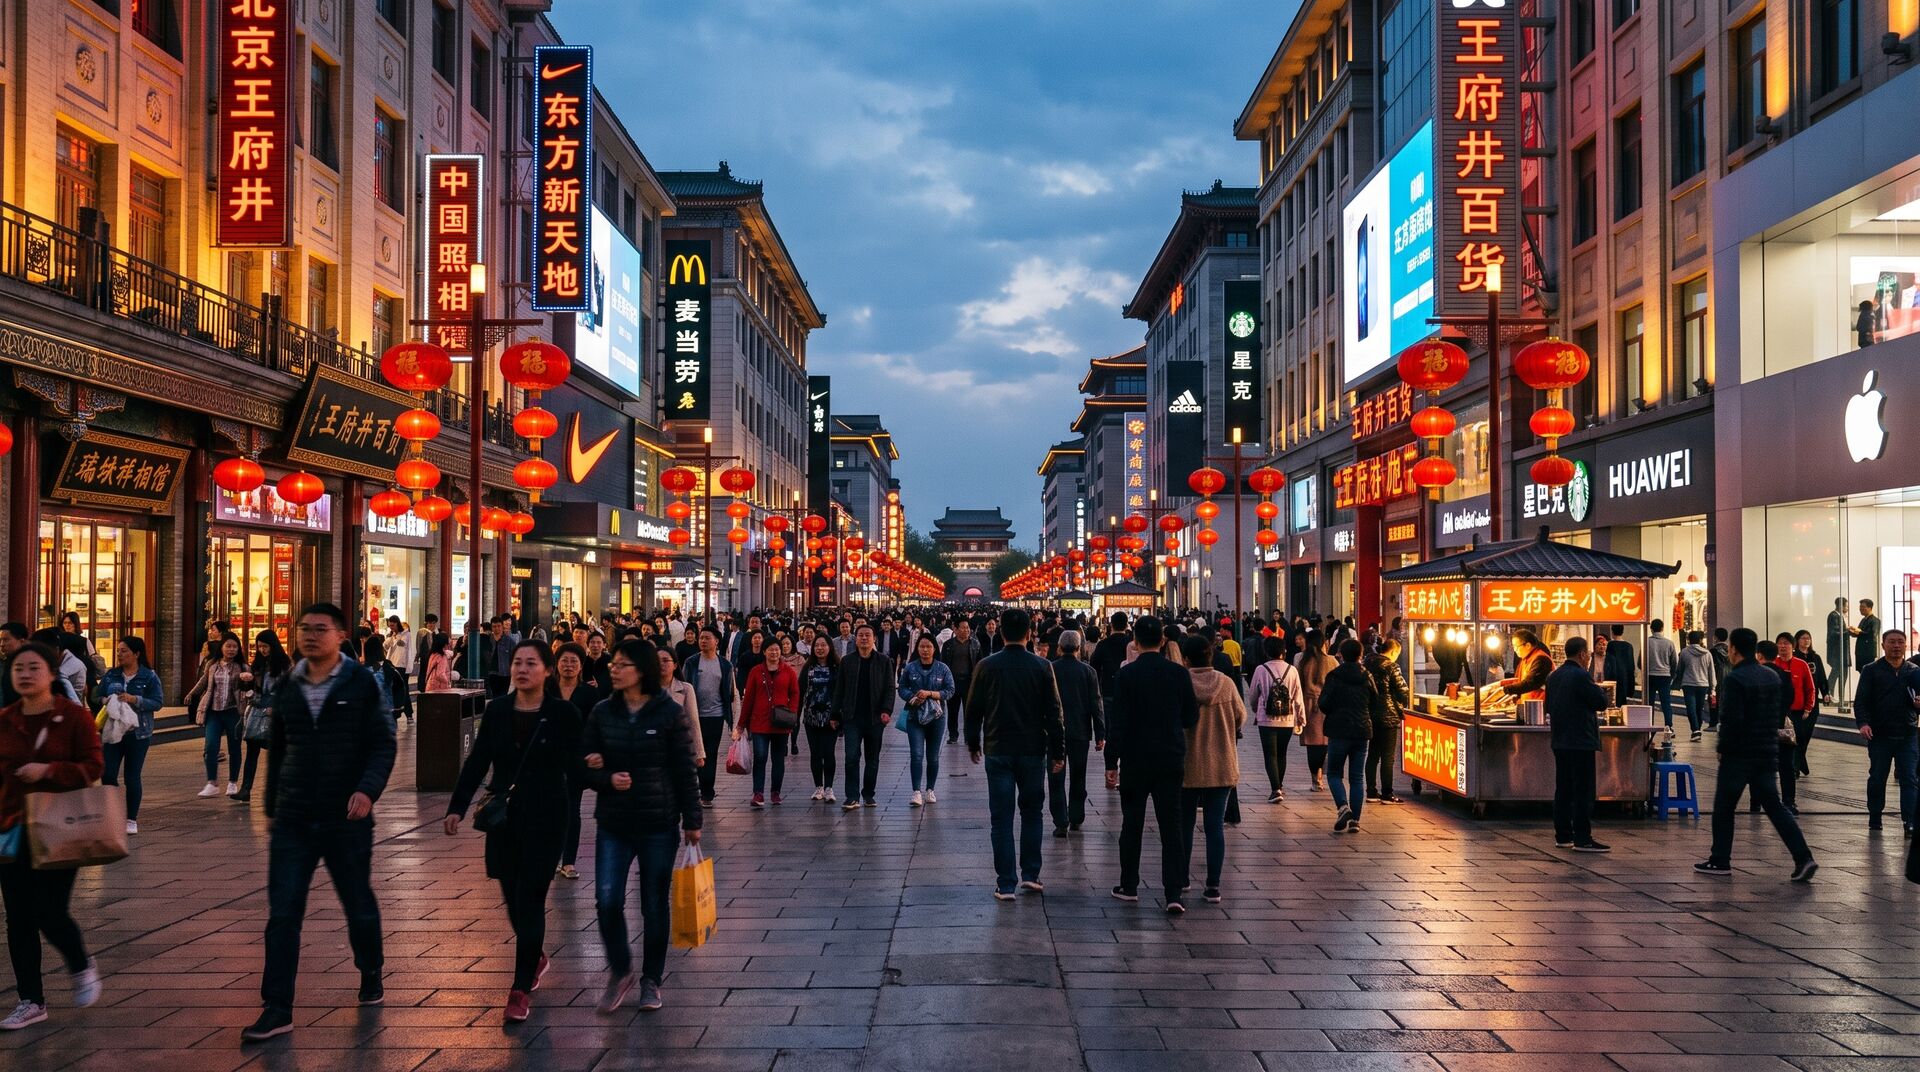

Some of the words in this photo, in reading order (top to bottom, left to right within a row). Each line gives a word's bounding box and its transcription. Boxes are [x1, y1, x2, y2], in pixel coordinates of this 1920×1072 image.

[1454, 19, 1505, 292] 王府井百货
[543, 93, 580, 297] 东方新天地
[674, 299, 701, 384] 麦当劳
[395, 350, 420, 375] 福
[520, 349, 546, 375] 福
[1232, 350, 1252, 401] 星克
[1421, 349, 1448, 373] 福
[1555, 350, 1580, 375] 福
[1168, 403, 1202, 413] adidas
[1351, 381, 1412, 440] 王府井百货
[1609, 448, 1691, 499] HUAWEI
[1523, 483, 1566, 519] 星巴克
[1408, 587, 1462, 616] 王府井小吃
[1487, 587, 1641, 615] 王府井小吃
[1404, 725, 1457, 780] 王府井小吃
